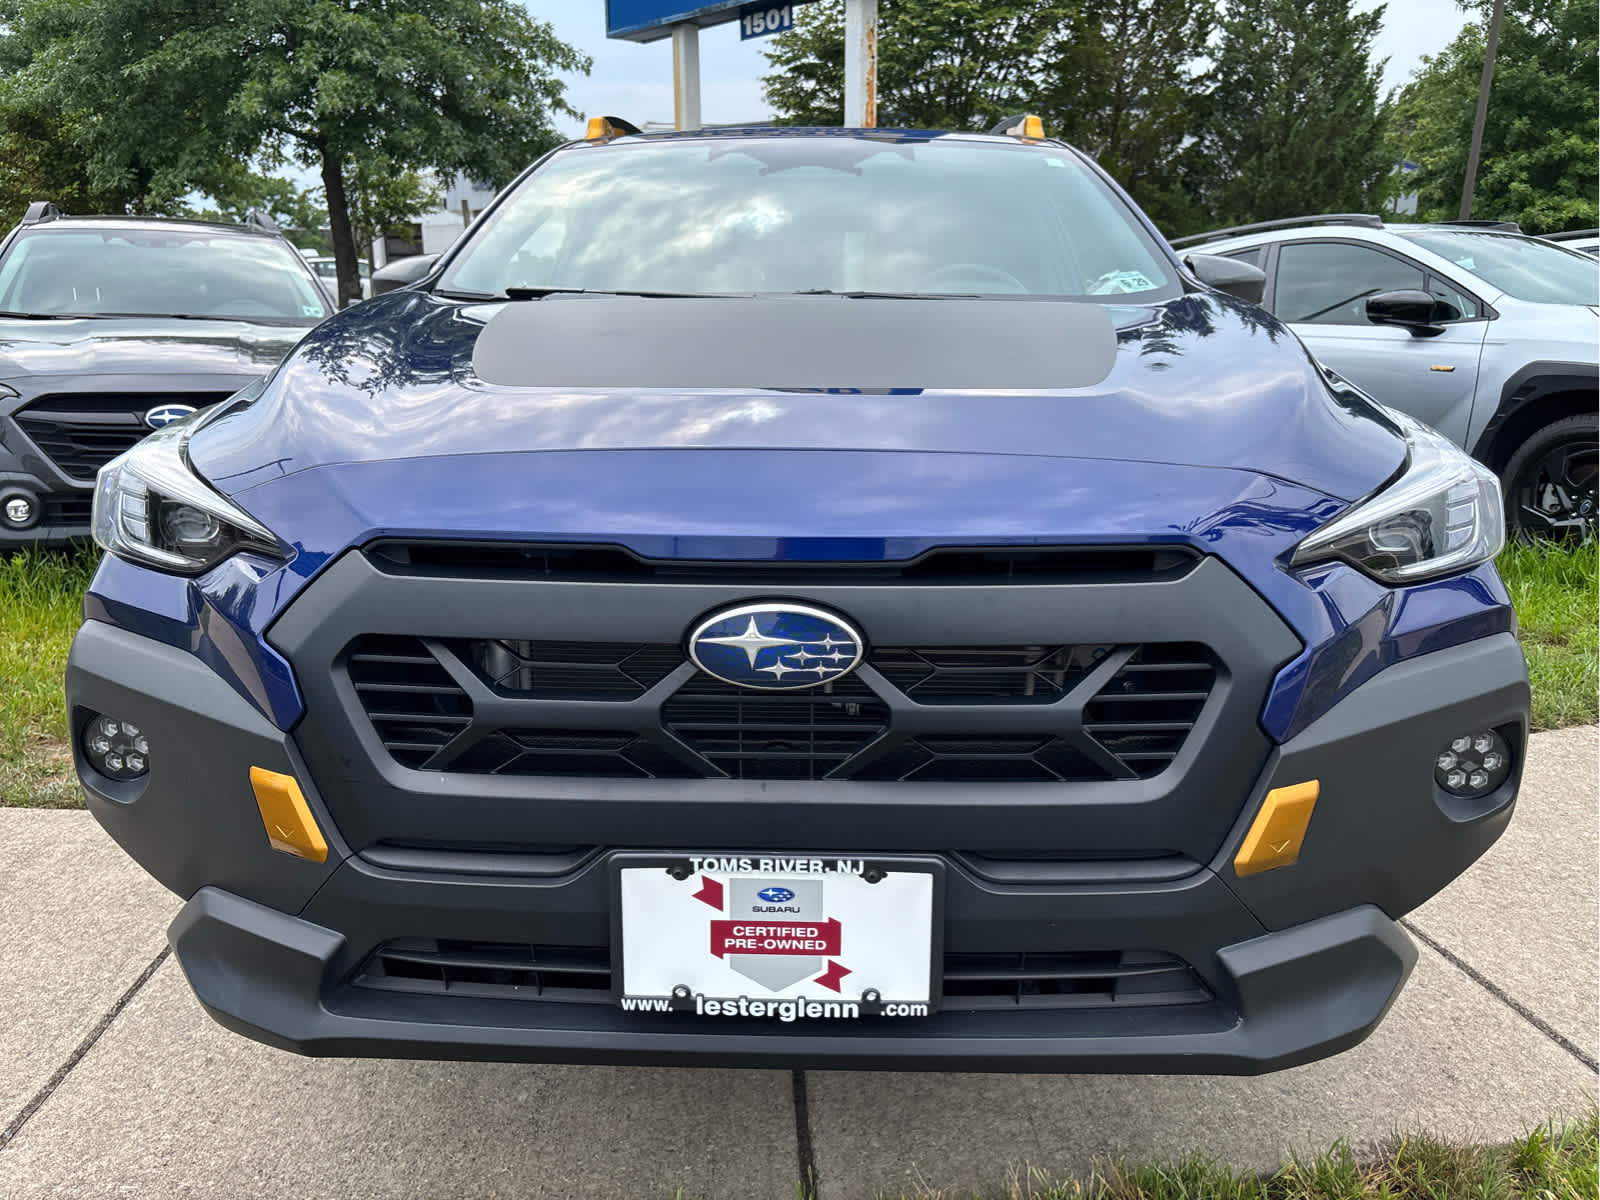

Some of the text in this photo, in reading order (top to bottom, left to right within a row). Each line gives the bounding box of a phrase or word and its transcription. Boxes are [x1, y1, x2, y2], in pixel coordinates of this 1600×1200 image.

[743, 5, 790, 35] 1501
[689, 858, 752, 873] TOMS
[837, 860, 865, 875] NJ
[752, 905, 801, 914] SUBARU
[732, 926, 819, 938] CERTIFIED
[724, 938, 827, 950] PRE-OWNED
[621, 995, 928, 1022] www. lesterglenn .com
